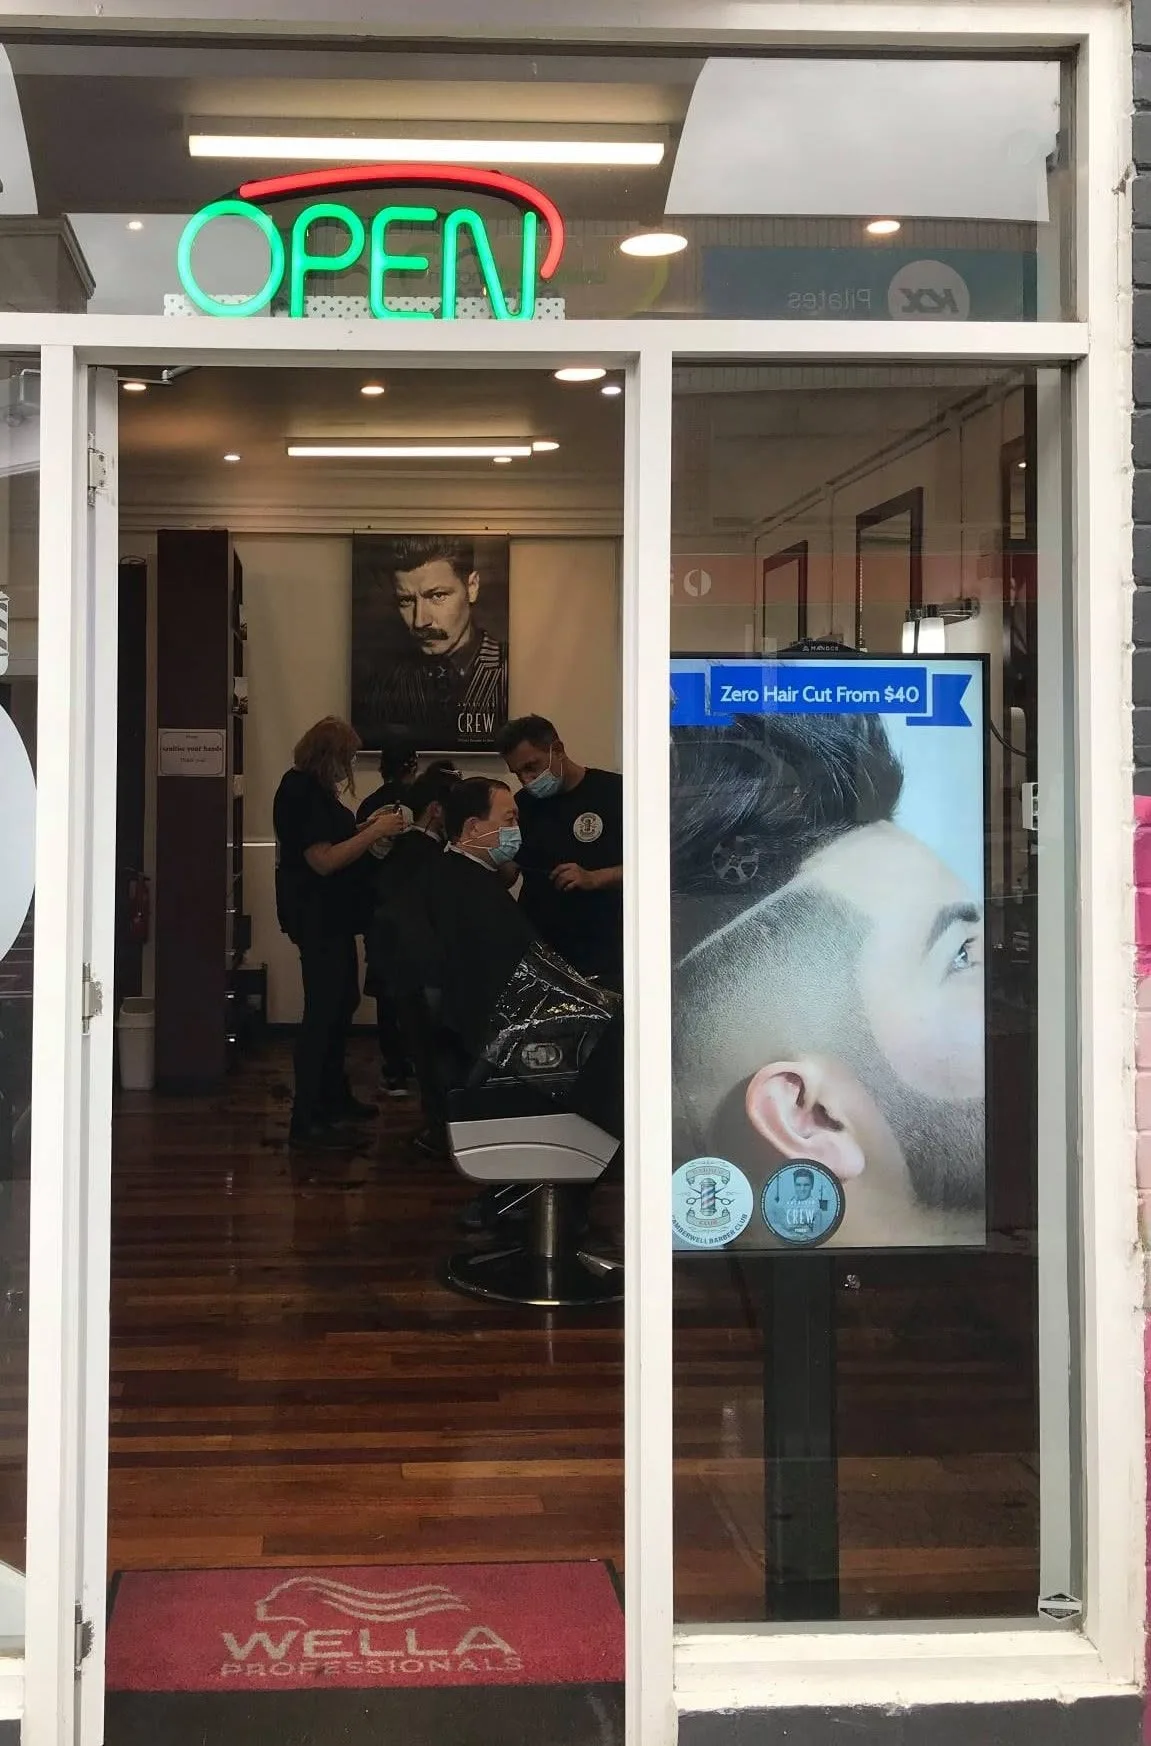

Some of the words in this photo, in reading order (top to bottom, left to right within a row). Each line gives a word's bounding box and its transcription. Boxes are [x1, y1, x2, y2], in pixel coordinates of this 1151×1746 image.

[177, 199, 537, 321] OPEN
[720, 685, 760, 703] Zero
[763, 685, 799, 703] Hair
[802, 685, 833, 703] Cut
[836, 685, 880, 703] From
[883, 684, 920, 704] $40
[457, 712, 495, 733] CREW
[786, 1208, 814, 1225] CREW
[708, 1229, 737, 1245] BARBER
[734, 1213, 749, 1231] CLUB
[220, 1625, 517, 1661] WELLA
[219, 1656, 525, 1678] PROFESSIONALS
